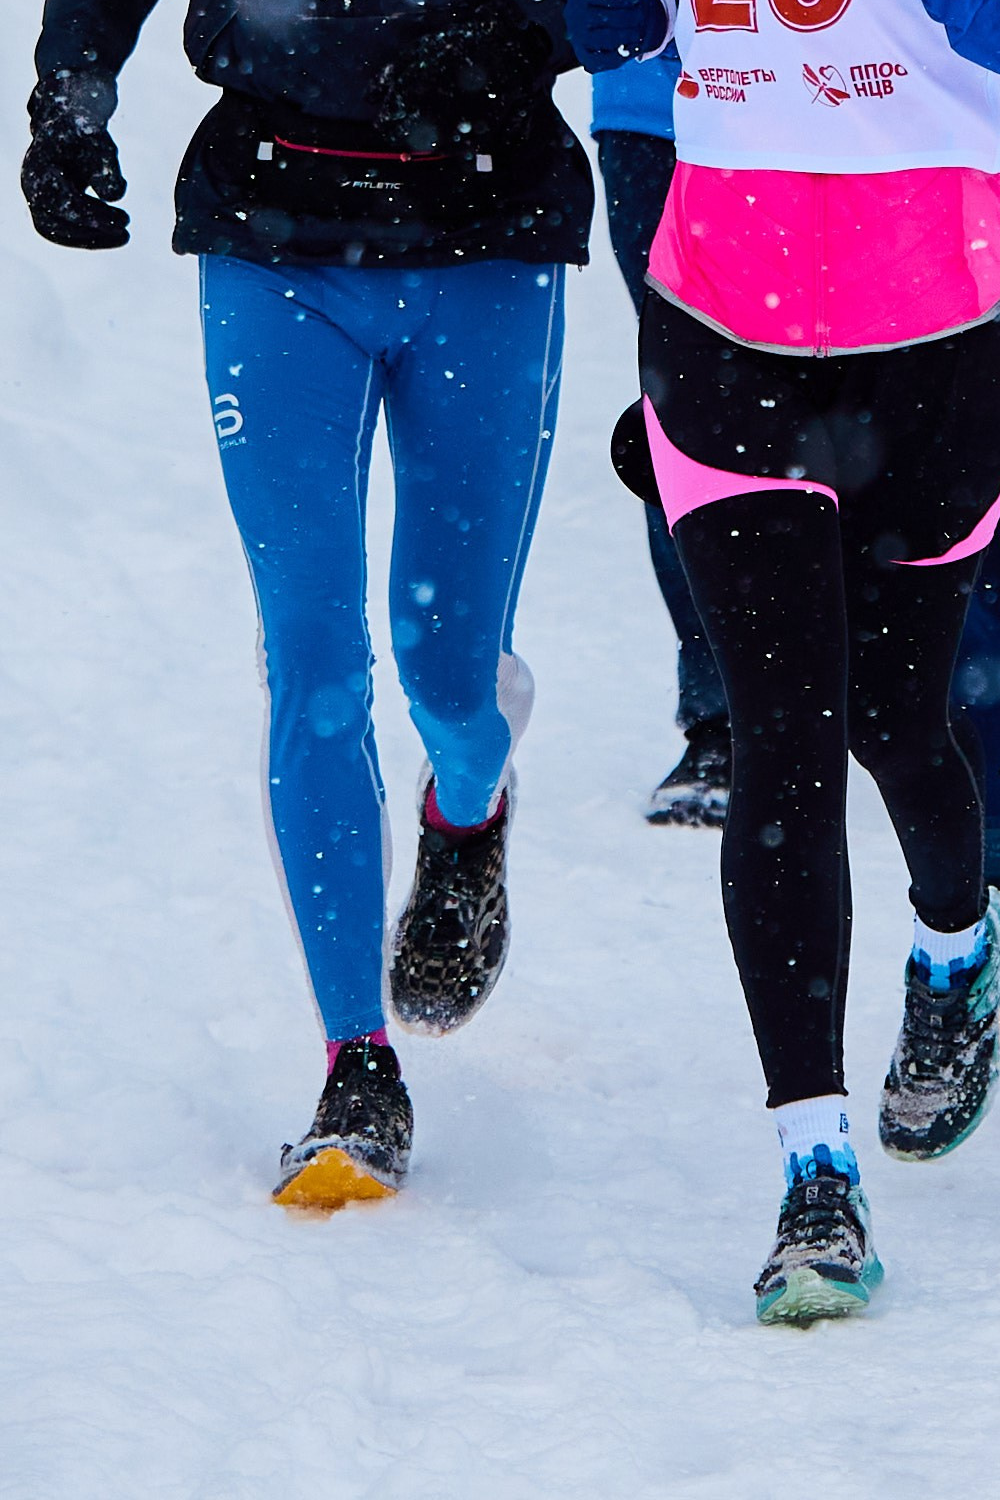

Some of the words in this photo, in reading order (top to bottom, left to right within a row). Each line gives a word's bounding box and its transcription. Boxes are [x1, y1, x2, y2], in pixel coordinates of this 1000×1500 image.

[698, 68, 777, 86] ВЕРТОЛЕТЫ
[705, 84, 746, 102] РОССИИ
[854, 79, 894, 99] НЦВ
[353, 181, 400, 190] FITLETIC
